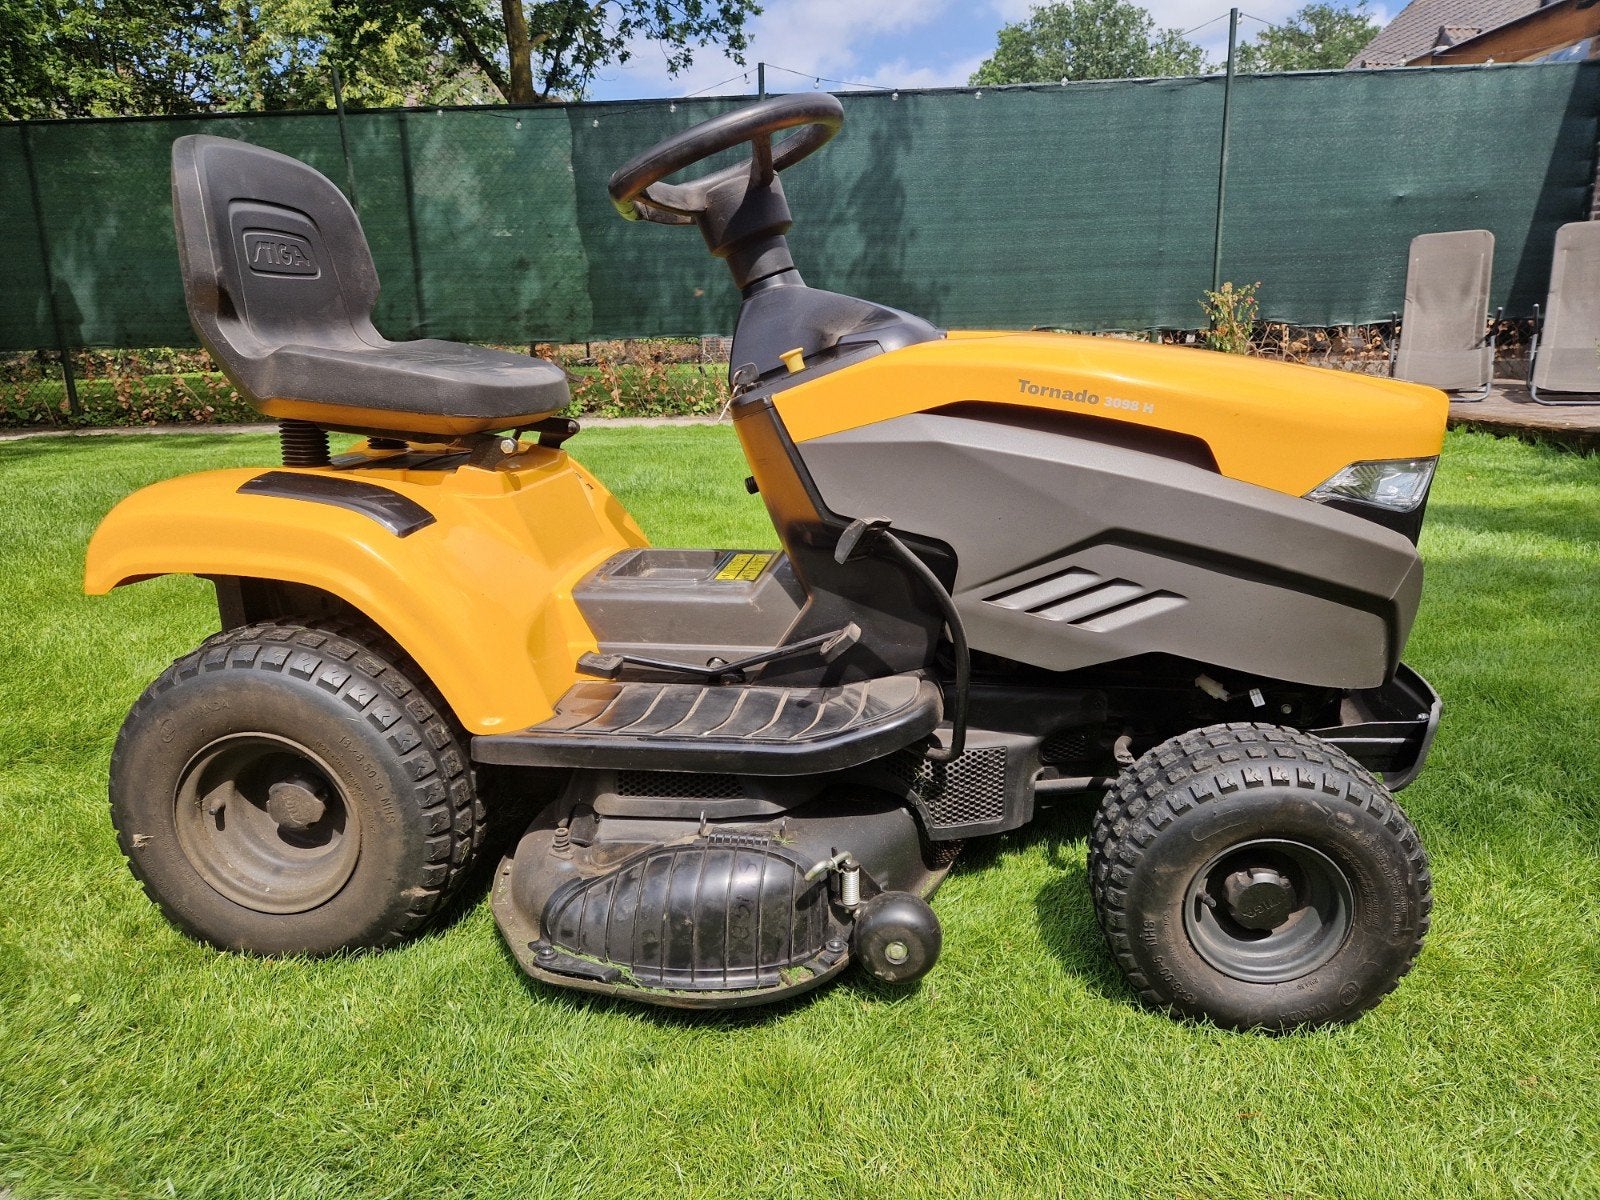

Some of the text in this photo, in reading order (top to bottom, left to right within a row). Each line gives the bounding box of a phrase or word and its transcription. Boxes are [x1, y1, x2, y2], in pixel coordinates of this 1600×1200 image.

[253, 240, 311, 267] STIGA
[1018, 378, 1156, 415] Tornado 3098 H
[1143, 917, 1158, 948] NHS
